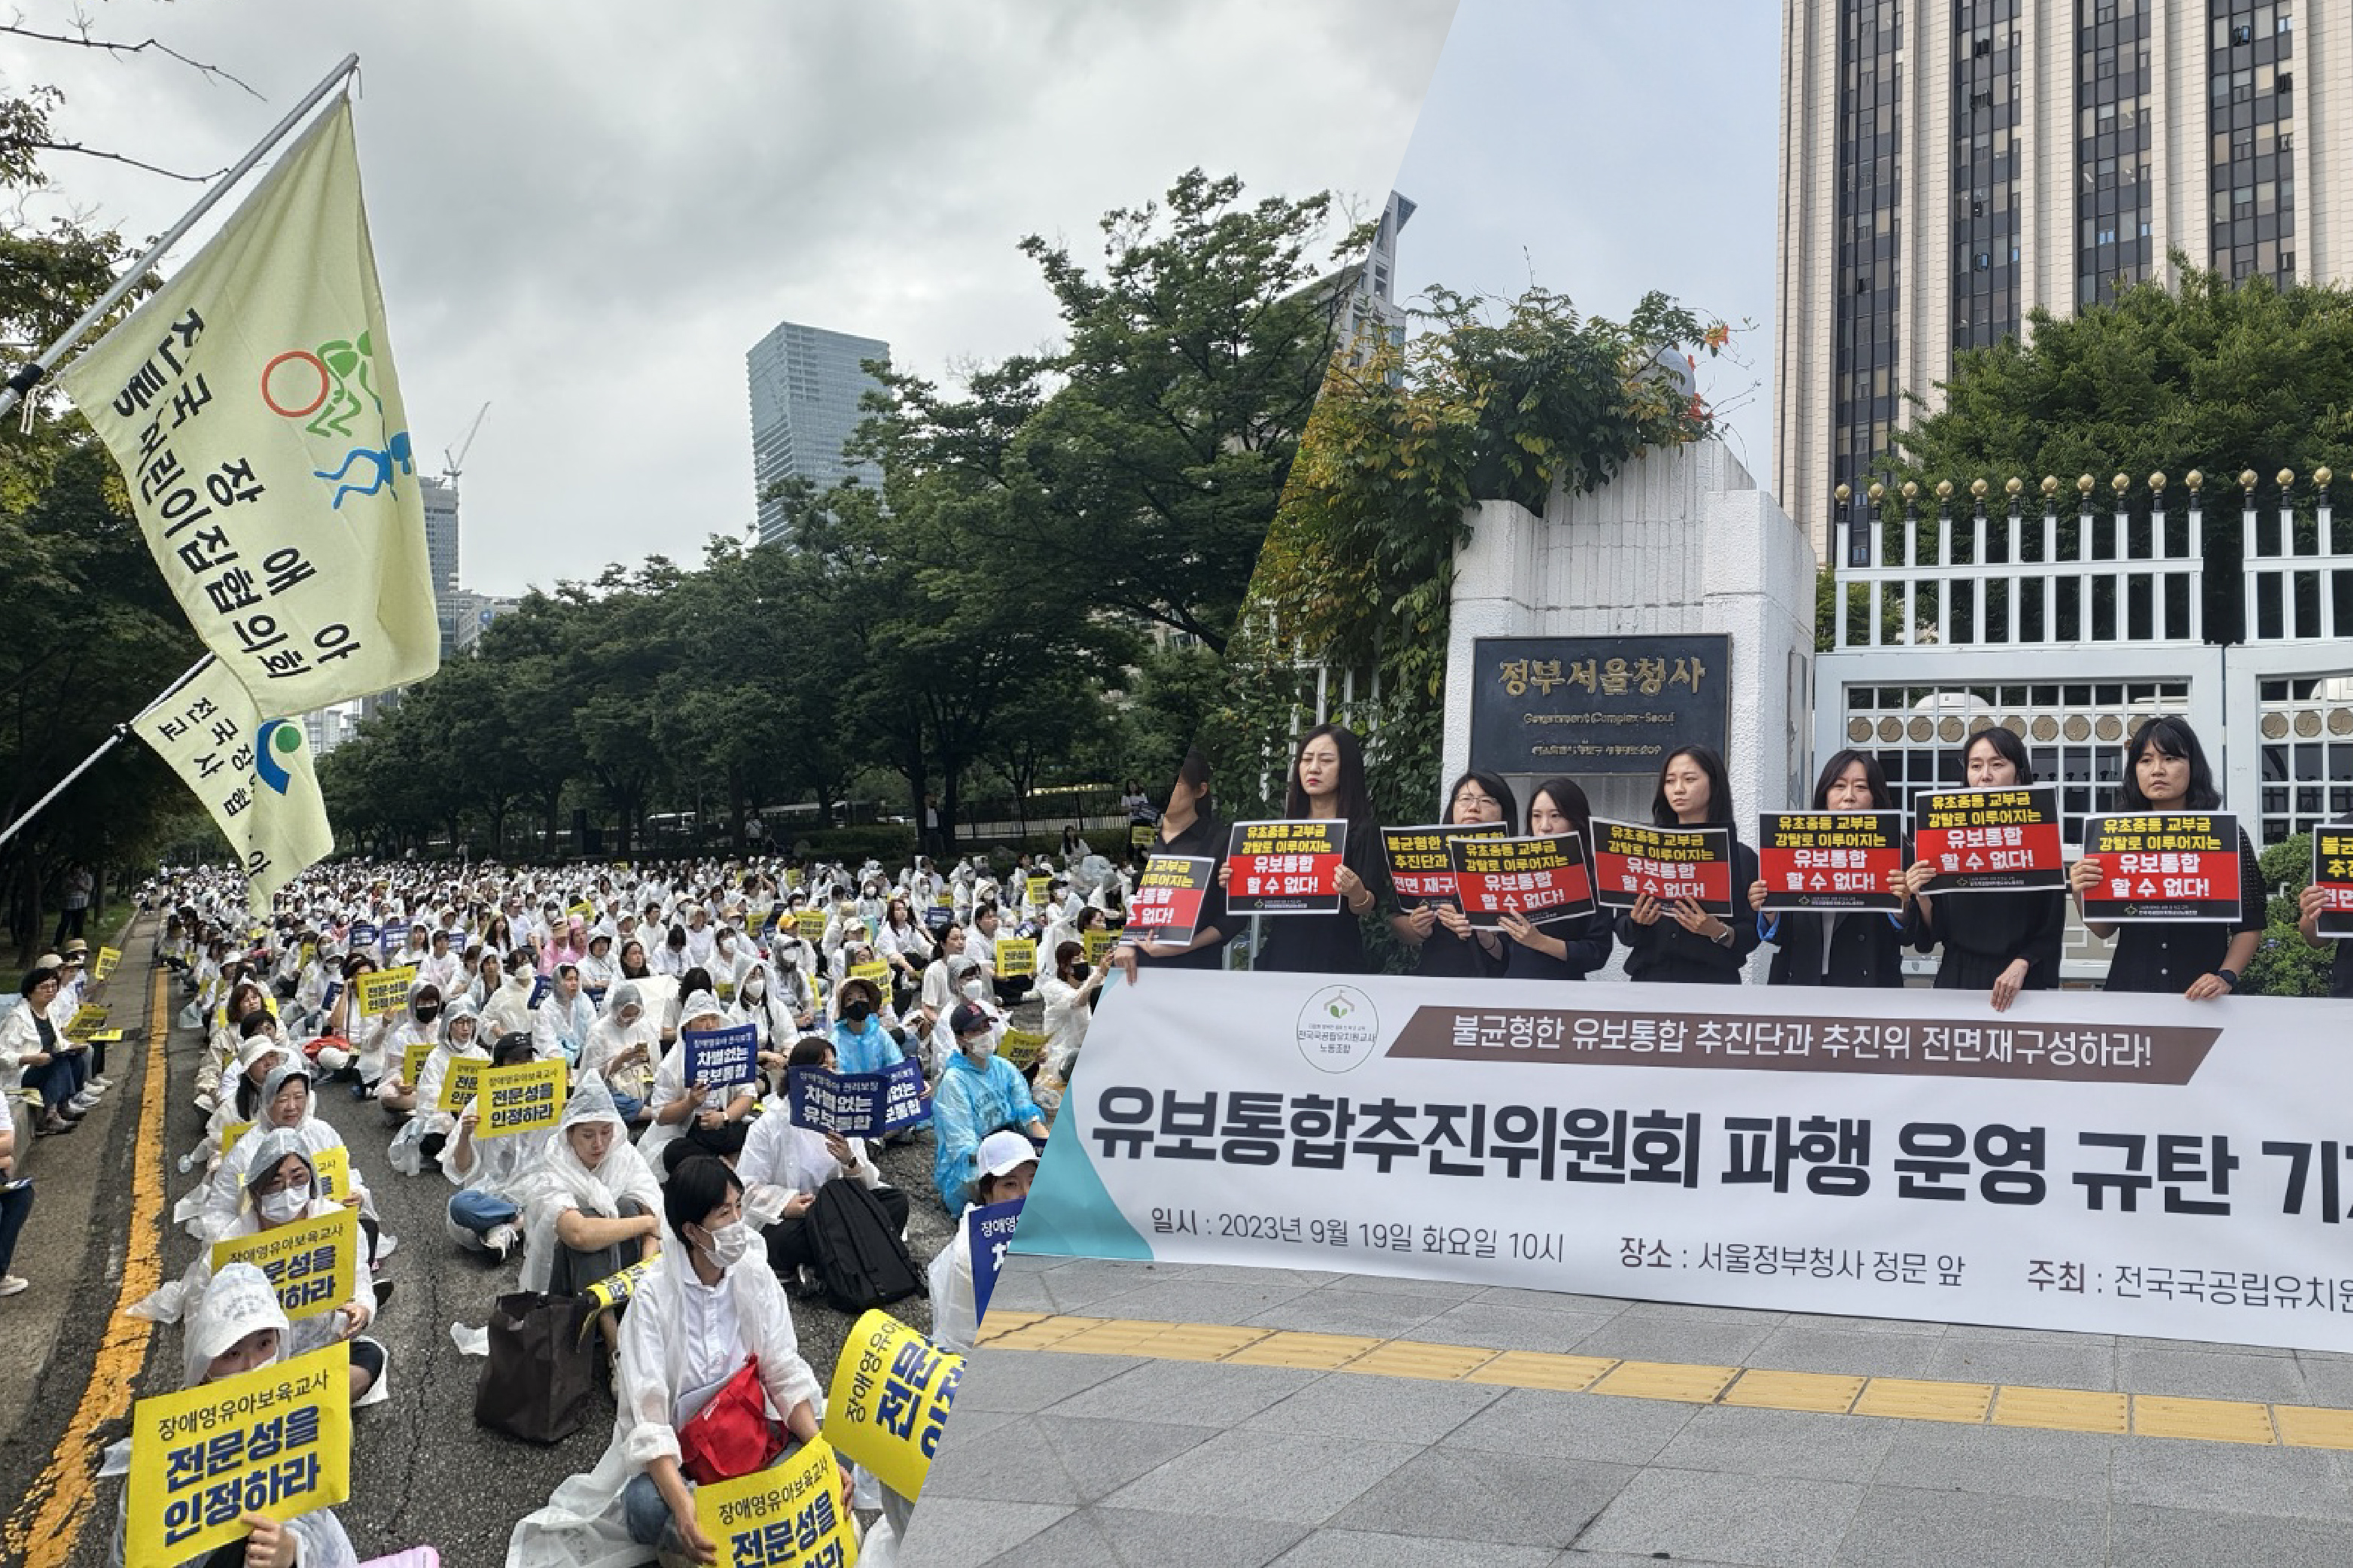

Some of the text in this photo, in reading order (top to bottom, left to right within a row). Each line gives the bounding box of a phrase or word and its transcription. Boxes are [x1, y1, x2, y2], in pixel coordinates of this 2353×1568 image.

[1498, 657, 1705, 696] 정부서울청사
[1524, 711, 1589, 724] Government
[1932, 792, 2030, 808] 유초중등 교부금
[1778, 817, 1877, 830] 유초중등 교부금
[1929, 810, 2041, 827] 강탈로 이루어지는
[2104, 817, 2211, 833] 유초중등 교부금
[1247, 824, 1326, 839] 유초중등 교부금
[1611, 826, 1704, 846] 유초중등 교부금
[1775, 833, 1887, 846] 강탈로 이루어지는
[1947, 828, 2022, 846] 유보통합
[1242, 840, 1331, 854] 강탈로 이루어지는
[1388, 836, 1441, 851] 불균형한
[1465, 840, 1557, 857] 유초중등 교부금
[1608, 841, 1714, 861] 강탈로 이루어지는
[2099, 836, 2221, 851] 강탈로 이루어지는
[1253, 855, 1314, 873] 유보통합
[1394, 854, 1449, 869] 추진단과
[1465, 854, 1569, 872] 강탈로 이루어지는
[1627, 858, 1696, 879] 유보통합
[1794, 851, 1867, 868] 유보통합
[1940, 851, 2034, 871] 할 수 없다!
[2119, 856, 2200, 873] 유보통합
[1247, 877, 1318, 894] 할 수 없다!
[1483, 872, 1553, 891] 유보통합
[1621, 875, 1705, 897] 할 수 없다!
[1786, 872, 1875, 890] 할 수 없다!
[2111, 878, 2209, 897] 할 수 없다!
[1481, 889, 1565, 909] 할 수 없다!
[1452, 1015, 2153, 1067] 불균형한 유보통합 추진단과 추진위 전면재구성하라!
[696, 1046, 749, 1066] 차별없는
[492, 1082, 555, 1107] 전문성을
[804, 1084, 873, 1113] 차별없는
[490, 1103, 554, 1128] 인정하라
[803, 1106, 873, 1131] 유보통합
[1093, 1086, 2353, 1225] 유보통합추진위원회 파행 운영 규탄 기
[1151, 1207, 1197, 1236] 일시
[1218, 1213, 1302, 1244] 2023년
[1310, 1219, 1349, 1247] 9월
[1358, 1224, 1413, 1253] 19일
[1422, 1225, 1497, 1259] 화요일
[1510, 1233, 1564, 1263] 10시
[266, 1245, 336, 1282] 문성을
[1620, 1238, 1672, 1268] 장소
[1698, 1242, 1865, 1280] 서울정부청사
[1873, 1251, 1926, 1284] 정문
[1937, 1256, 1965, 1286] 앞
[2028, 1260, 2084, 1294] 주최
[158, 1369, 330, 1441] 장애영유아보육교사
[166, 1406, 319, 1493] 전문성을
[719, 1455, 828, 1525] 장애영유아보육교사
[165, 1454, 322, 1548] 인정하라
[730, 1489, 838, 1568] 전문성을
